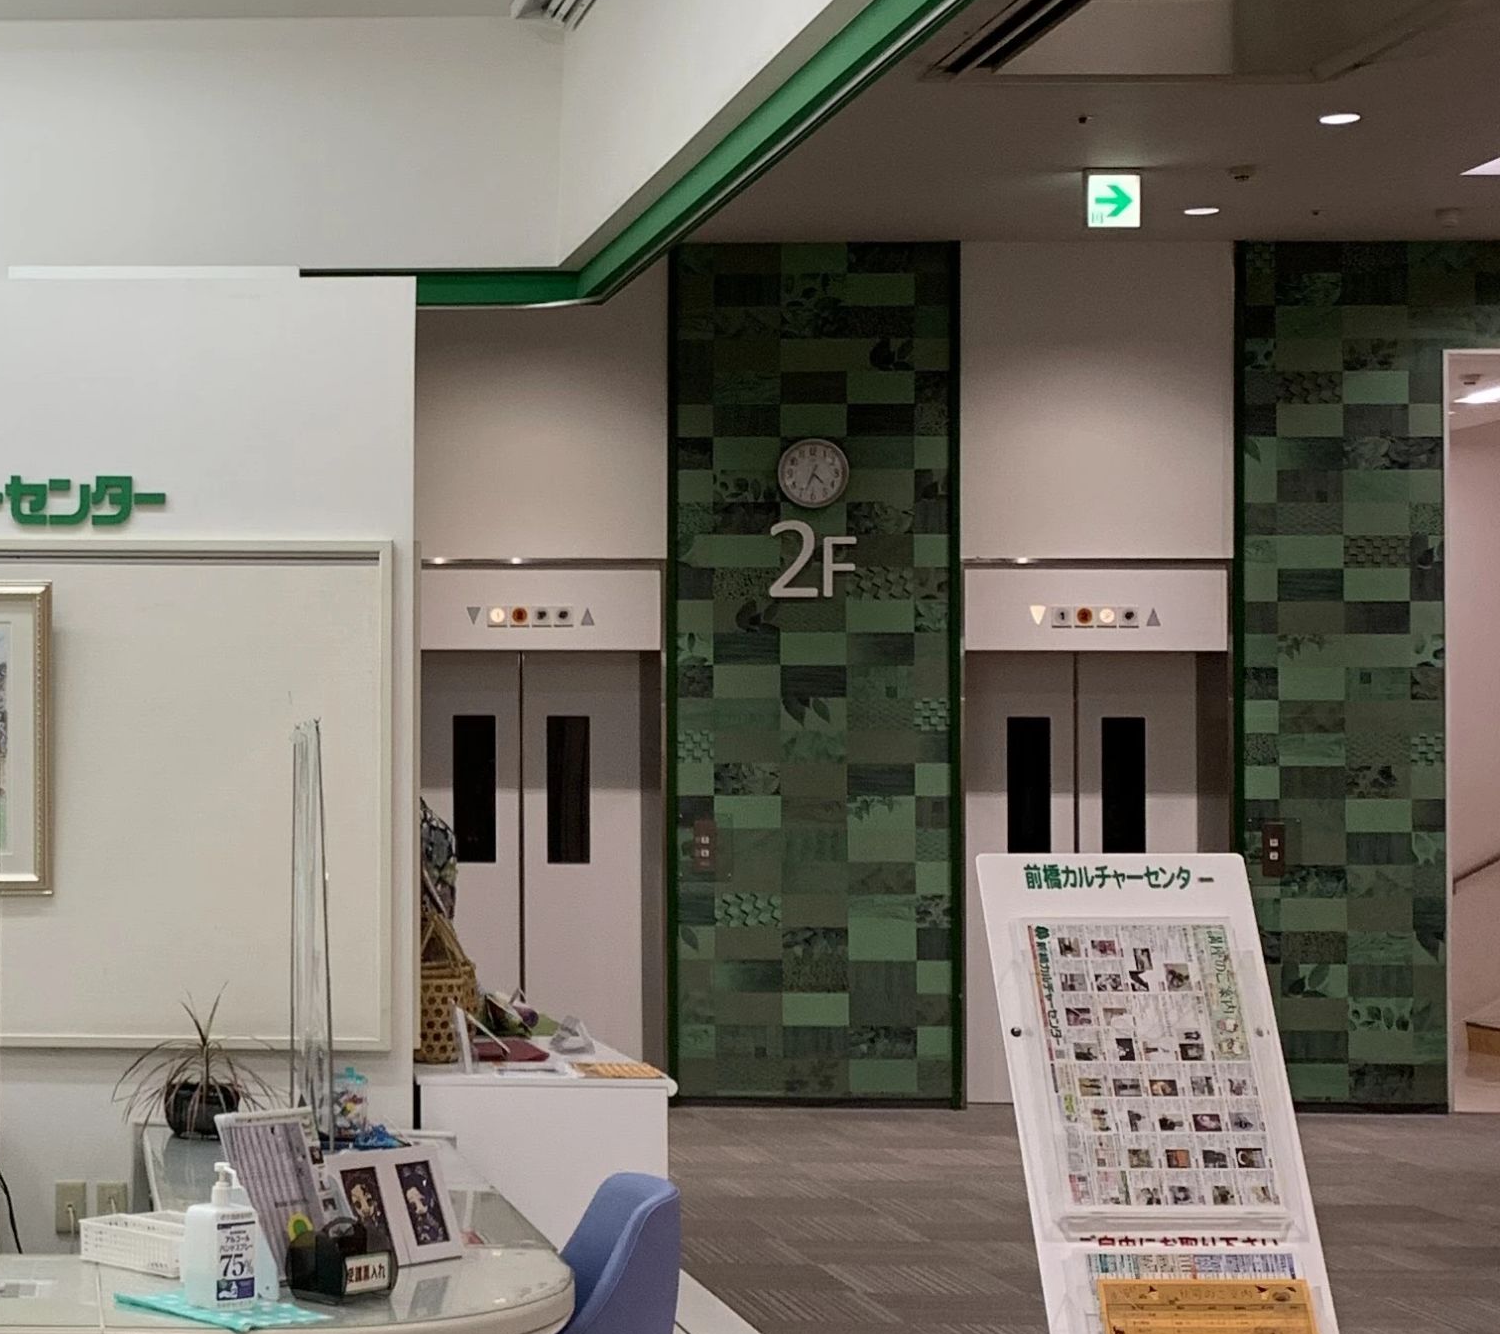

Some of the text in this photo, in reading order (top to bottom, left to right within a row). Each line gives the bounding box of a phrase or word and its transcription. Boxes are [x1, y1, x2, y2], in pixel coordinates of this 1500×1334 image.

[769, 520, 857, 598] 2F
[1023, 863, 1214, 889] 前橋カルチャーセンター
